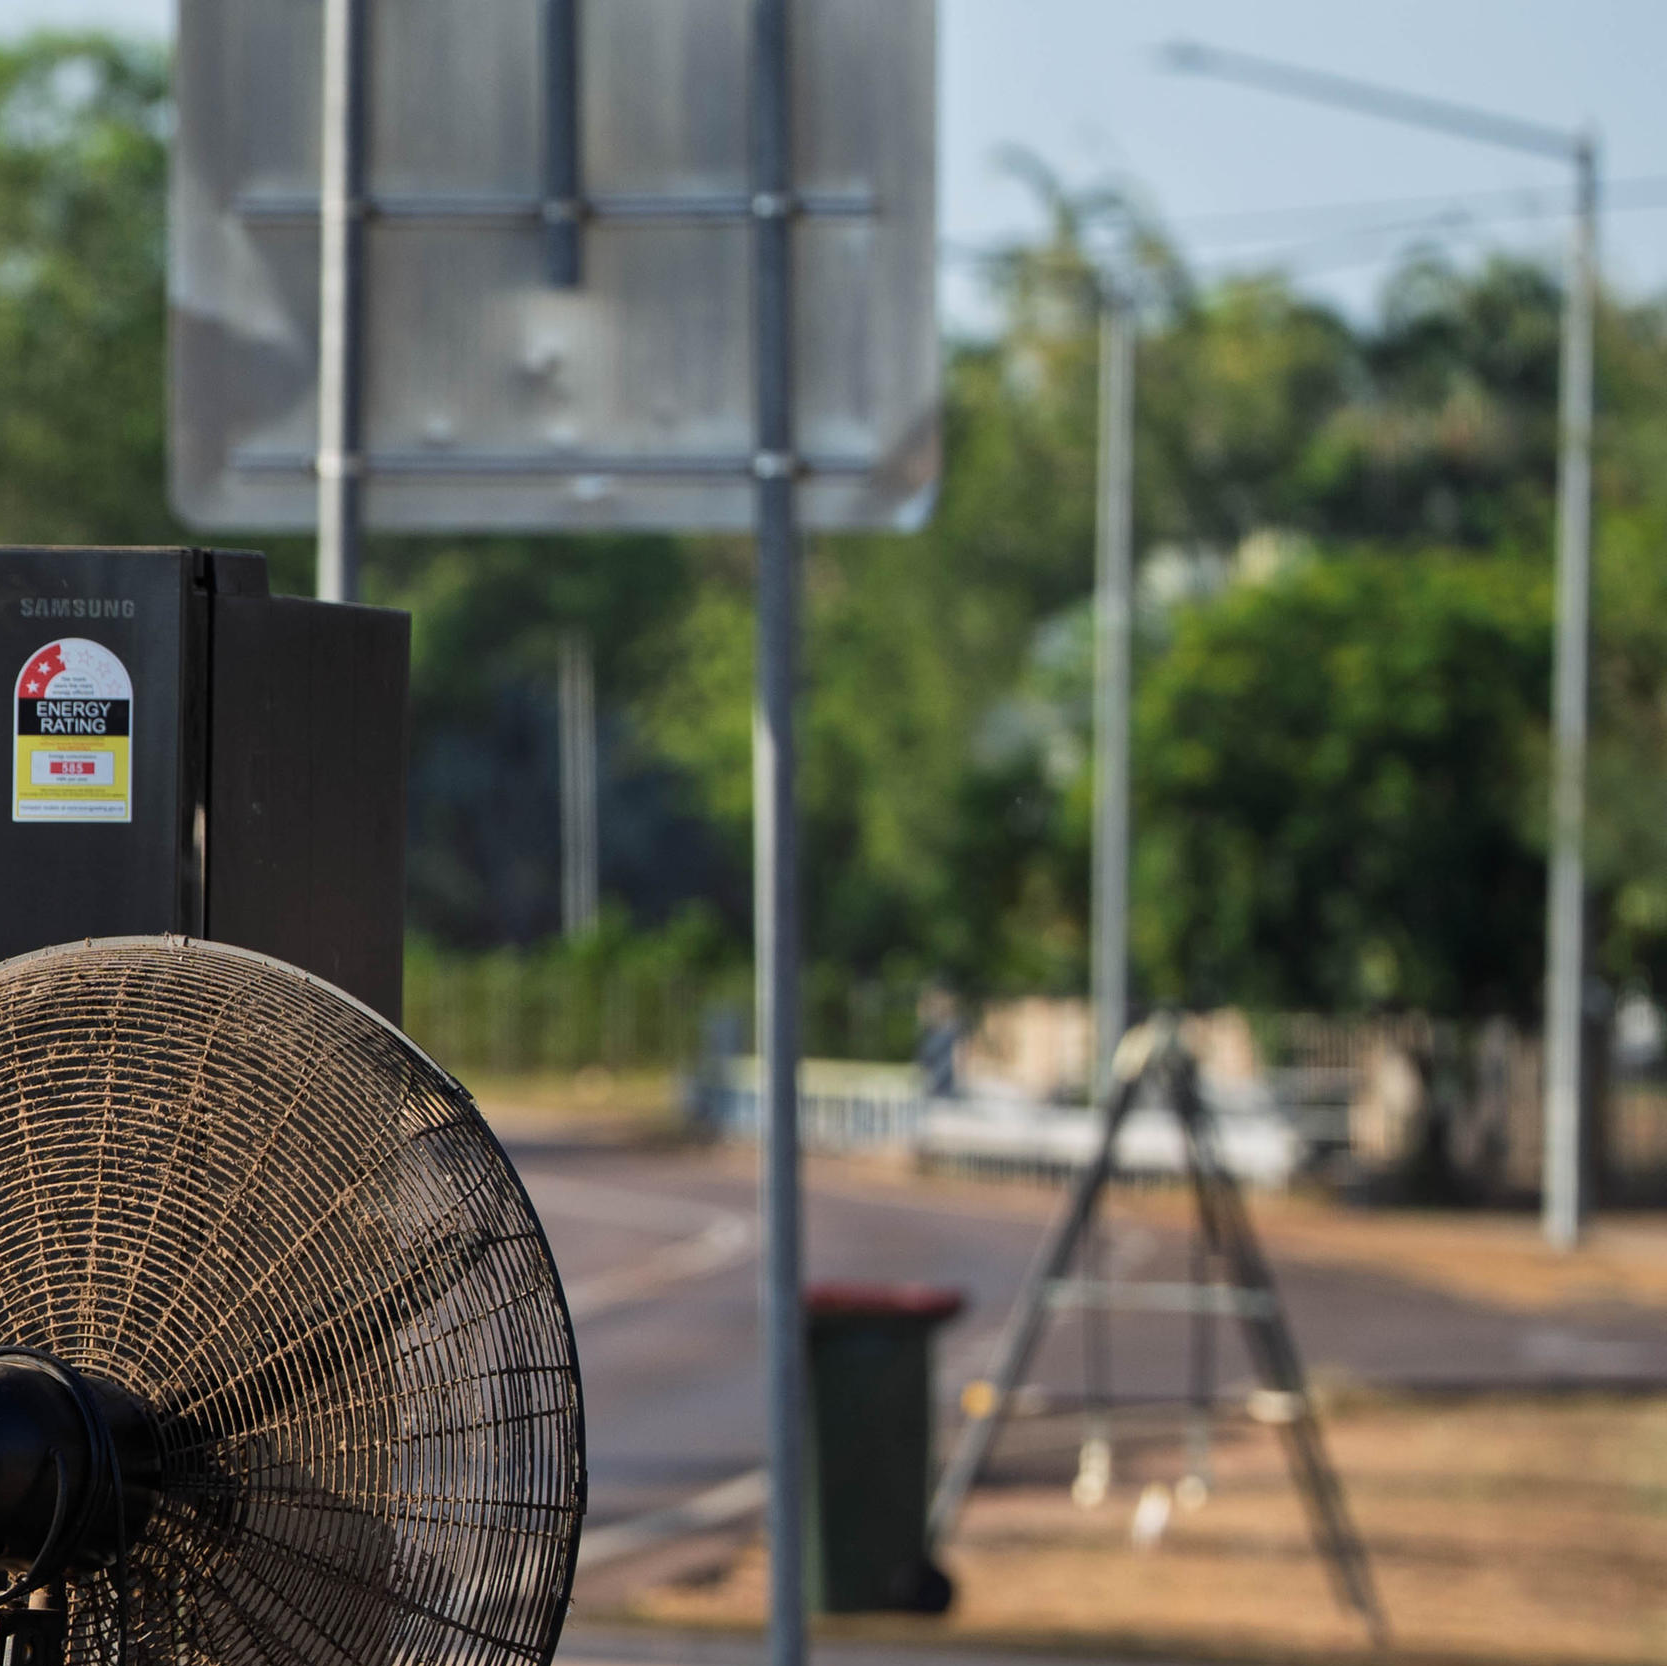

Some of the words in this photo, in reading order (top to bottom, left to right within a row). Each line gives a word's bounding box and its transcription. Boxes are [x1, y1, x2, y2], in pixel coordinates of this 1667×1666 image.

[20, 598, 135, 617] SAMSUNG
[36, 701, 111, 718] ENERGY
[40, 718, 106, 734] RATING
